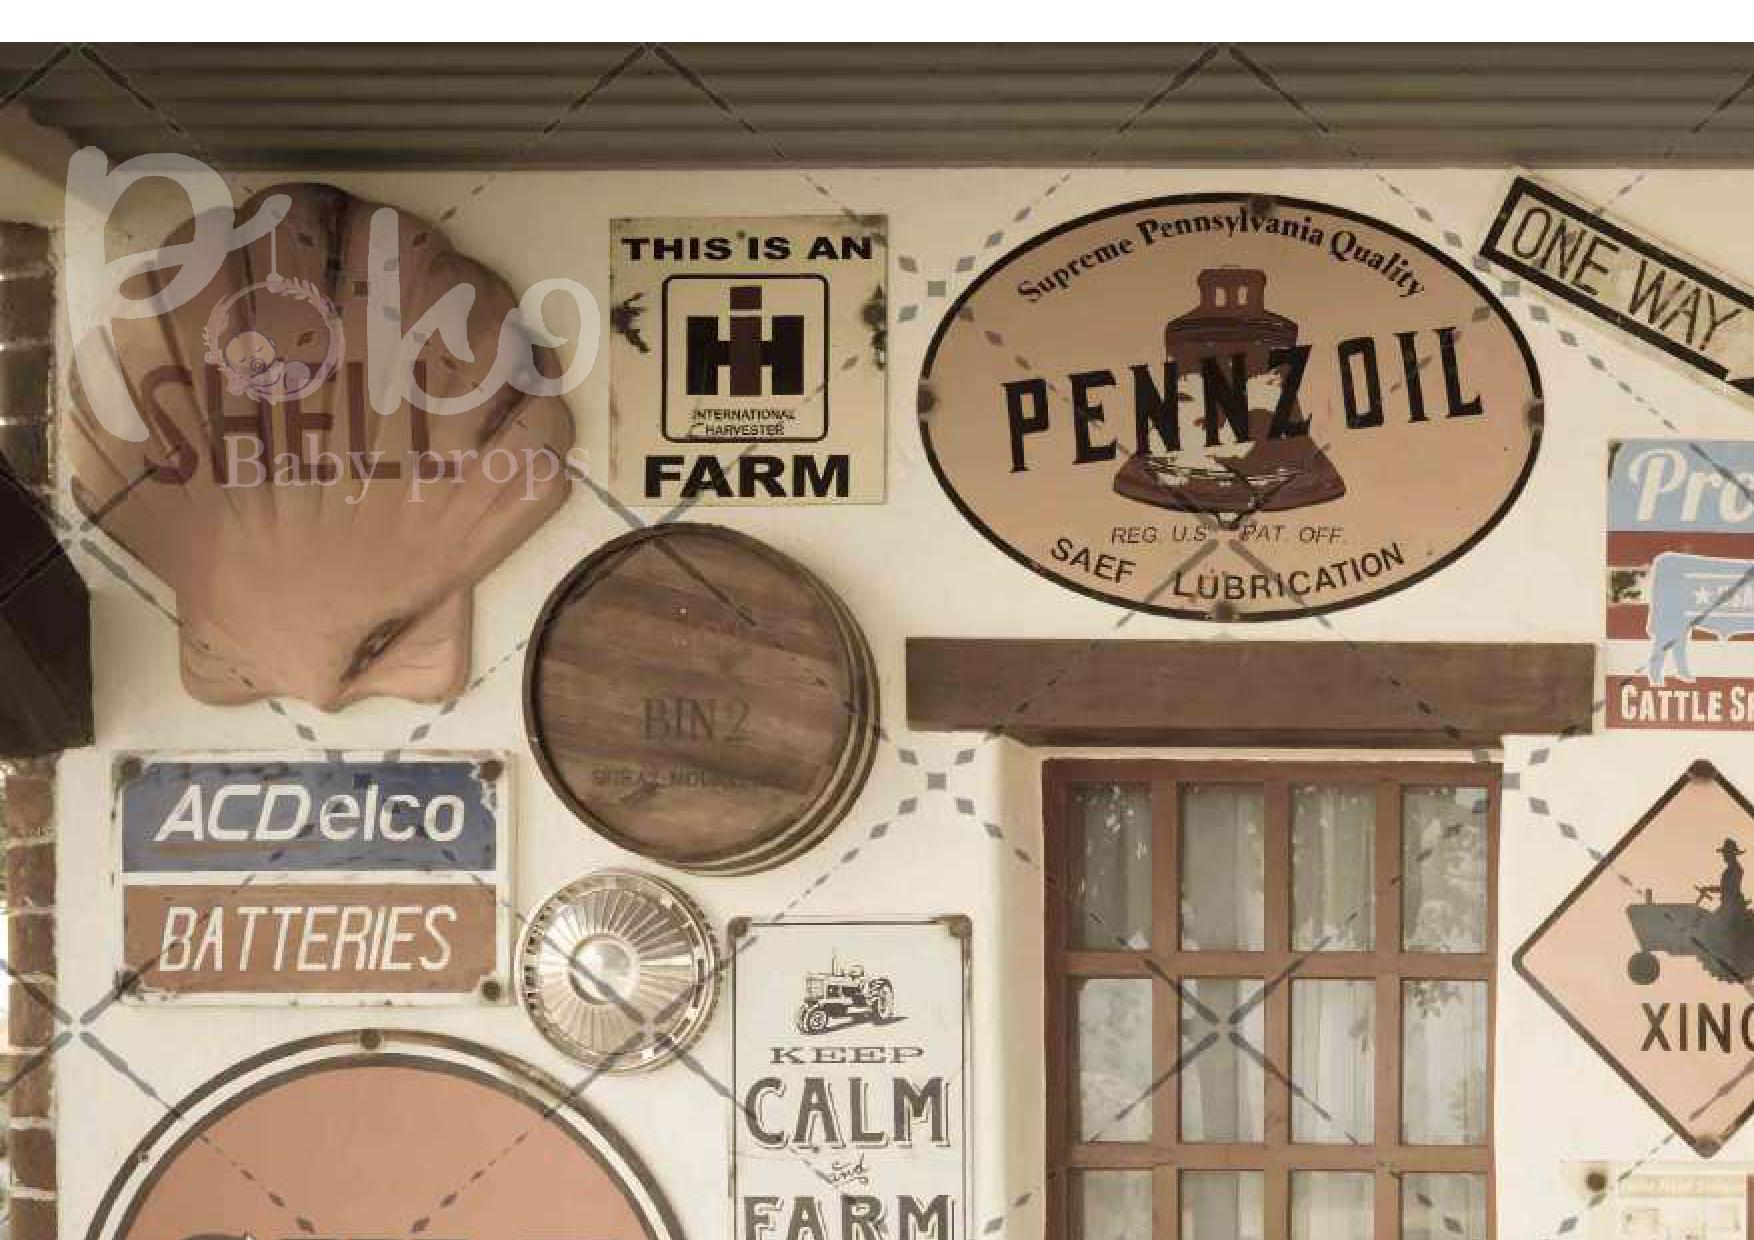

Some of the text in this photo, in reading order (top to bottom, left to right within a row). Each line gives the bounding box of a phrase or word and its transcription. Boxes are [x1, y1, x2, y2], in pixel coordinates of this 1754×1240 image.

[621, 236, 873, 261] THIS IS AN
[1016, 207, 1426, 304] Supreme Pennsylvania Quality
[1512, 206, 1744, 352] ONE WAY
[144, 360, 461, 486] SHELL
[692, 408, 797, 420] INTERNATIONAL
[705, 423, 785, 436] HARVESTER
[1002, 326, 1485, 475] PENNZOIL
[644, 455, 850, 498] FARM
[1050, 537, 1407, 601] SAEF LUBRICATION
[1620, 685, 1724, 723] CATTLE
[159, 906, 460, 972] BATTERIES
[770, 1046, 925, 1065] KEEP
[744, 1076, 951, 1149] CALM
